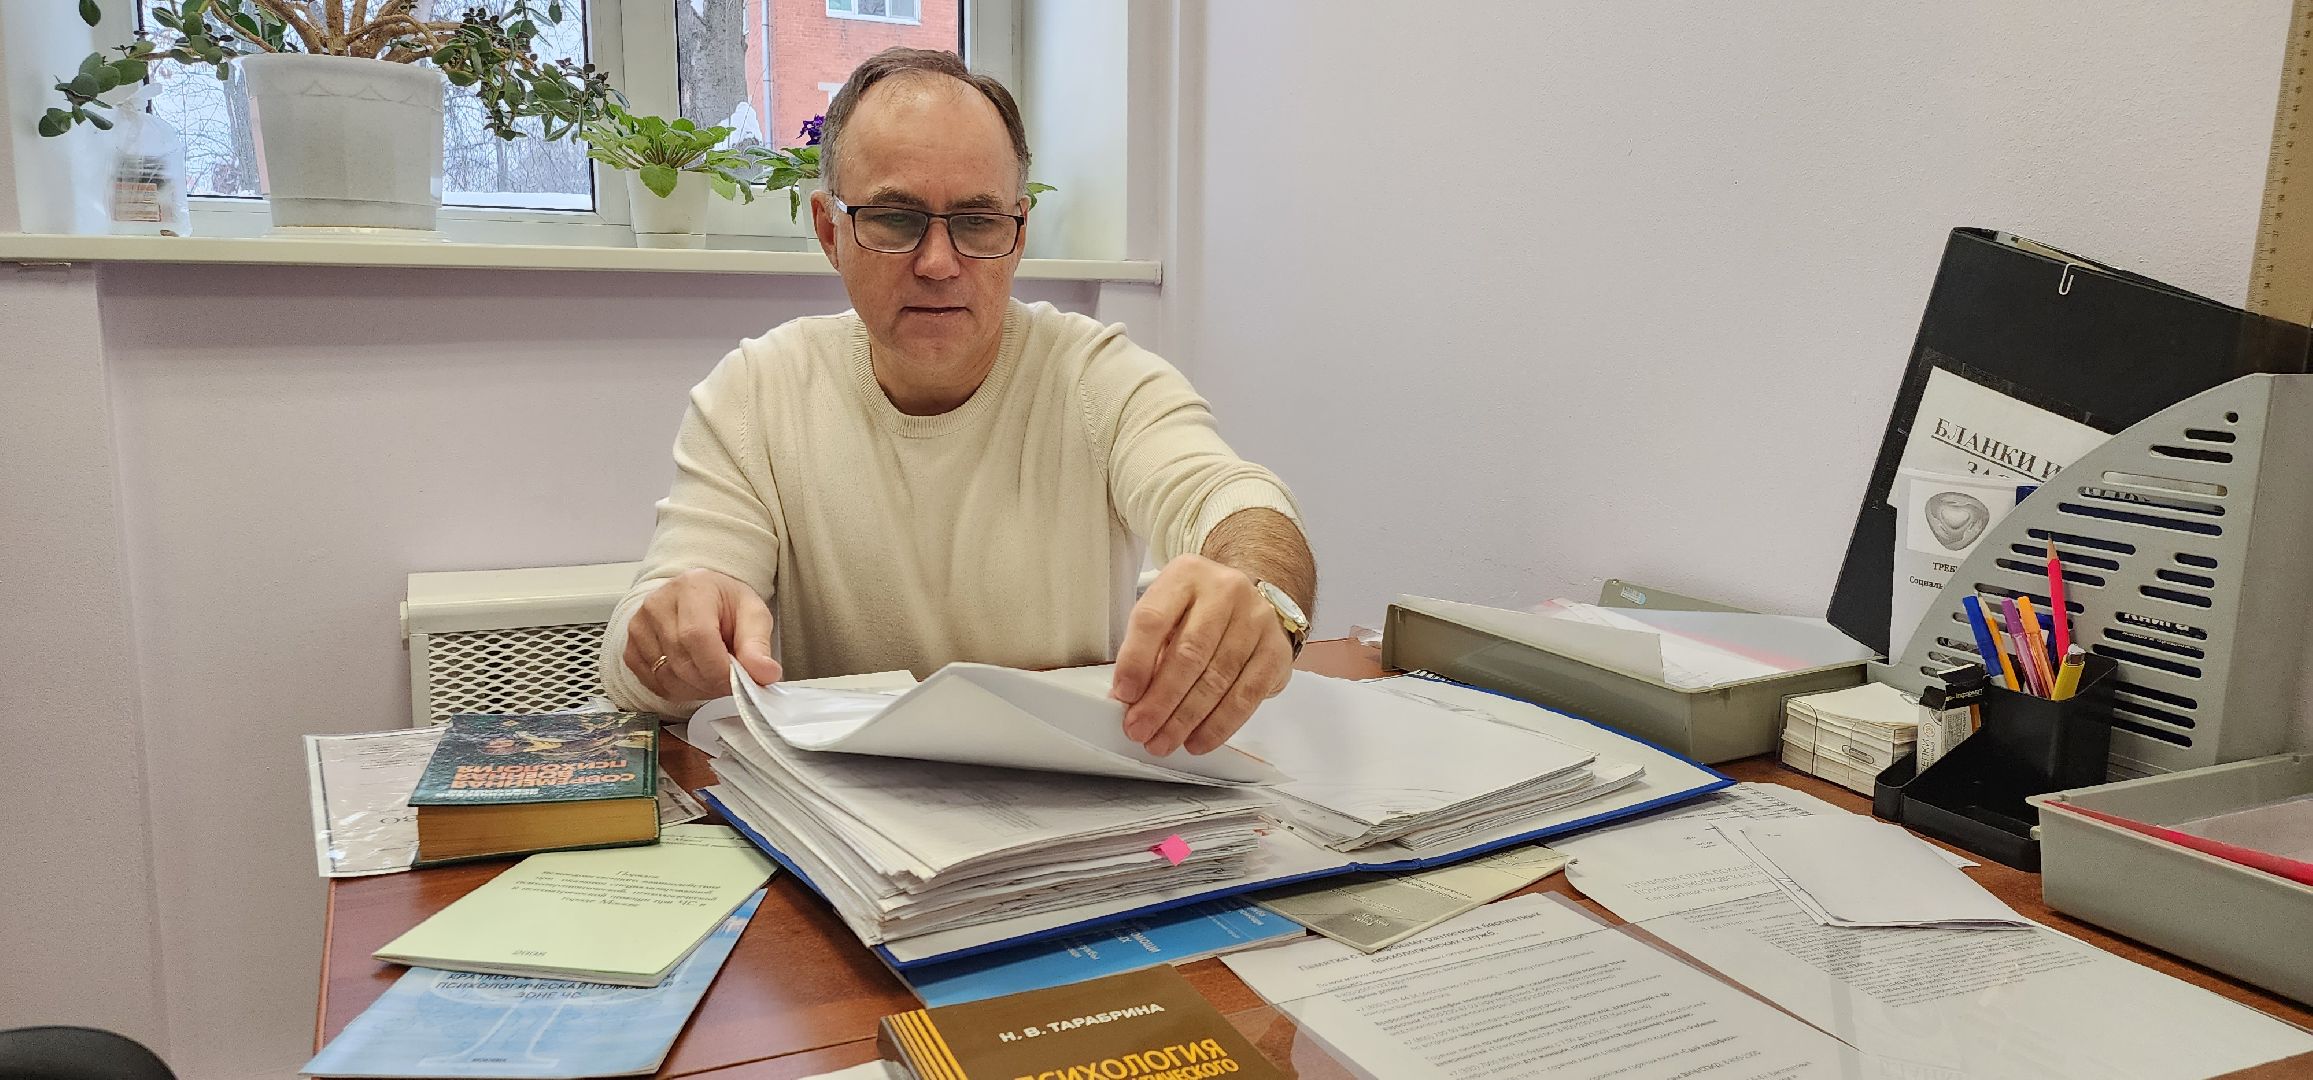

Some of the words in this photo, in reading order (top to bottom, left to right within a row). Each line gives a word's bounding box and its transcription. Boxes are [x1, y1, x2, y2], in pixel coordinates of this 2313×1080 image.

[1934, 417, 2036, 472] БЛАНКИ
[2042, 458, 2064, 479] И
[1909, 576, 1945, 590] Социаль
[457, 760, 627, 774] ПСИХОЛОГИЯ
[451, 773, 636, 789] СОВРЕМЕННАЯ
[455, 769, 574, 781] ВОЕННАЯ
[1298, 957, 1350, 971] Памятка
[1482, 911, 1541, 929] бесплатных
[1370, 938, 1459, 964] психологических
[435, 981, 588, 990] ПСИХОЛОГИЧЕСКАЯ
[515, 990, 558, 1000] ЗОНЕ
[998, 1031, 1023, 1043] Н.
[1023, 1026, 1047, 1039] В.
[1047, 1003, 1166, 1033] ТАРАБРИНА
